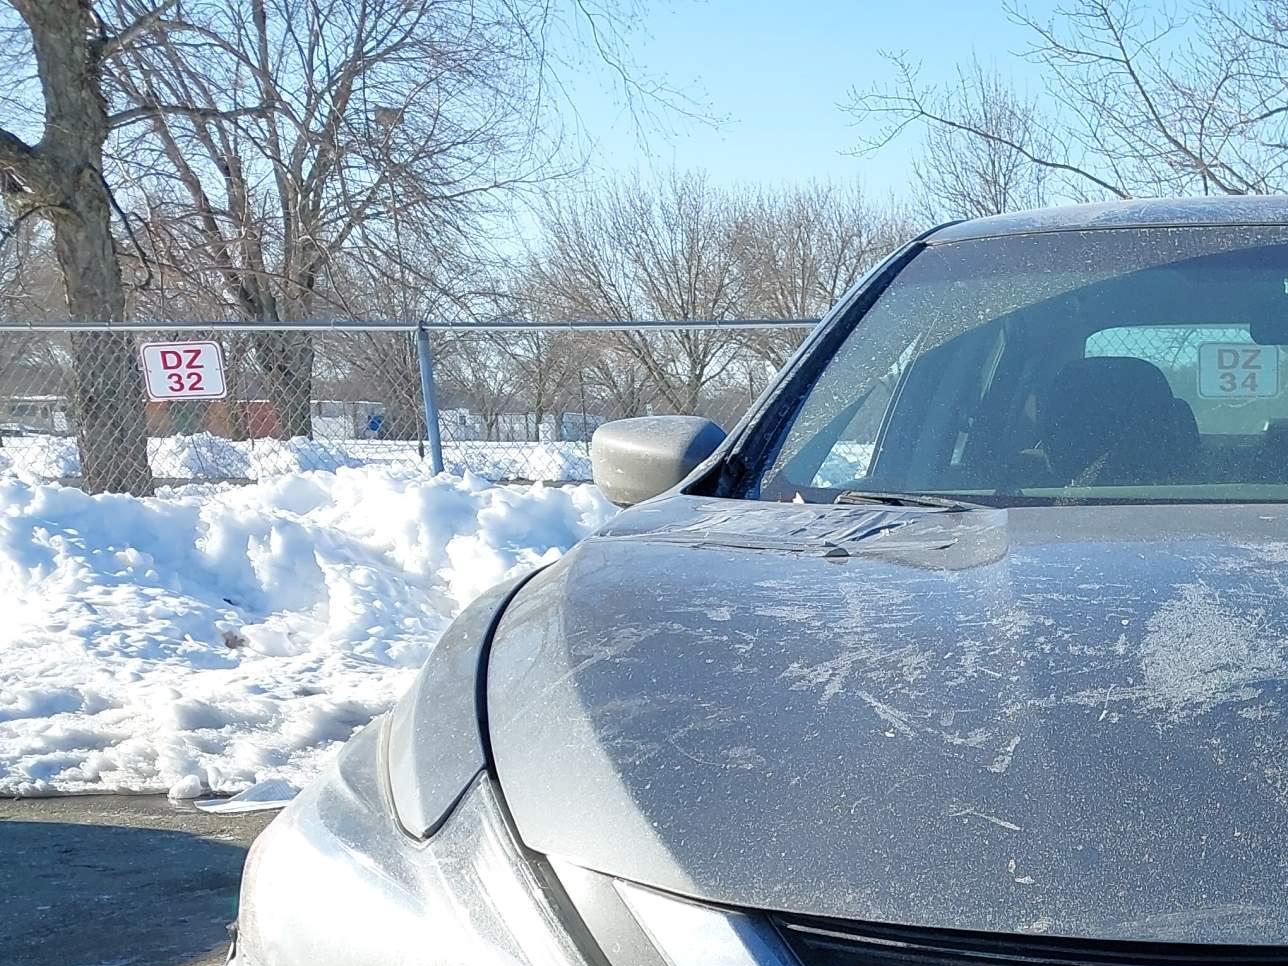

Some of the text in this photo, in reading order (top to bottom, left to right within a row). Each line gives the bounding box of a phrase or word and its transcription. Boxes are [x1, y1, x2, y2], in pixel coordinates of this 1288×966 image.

[160, 349, 204, 370] DZ
[1217, 348, 1262, 370] DZ
[167, 372, 205, 392] 32
[1219, 372, 1258, 393] 34
